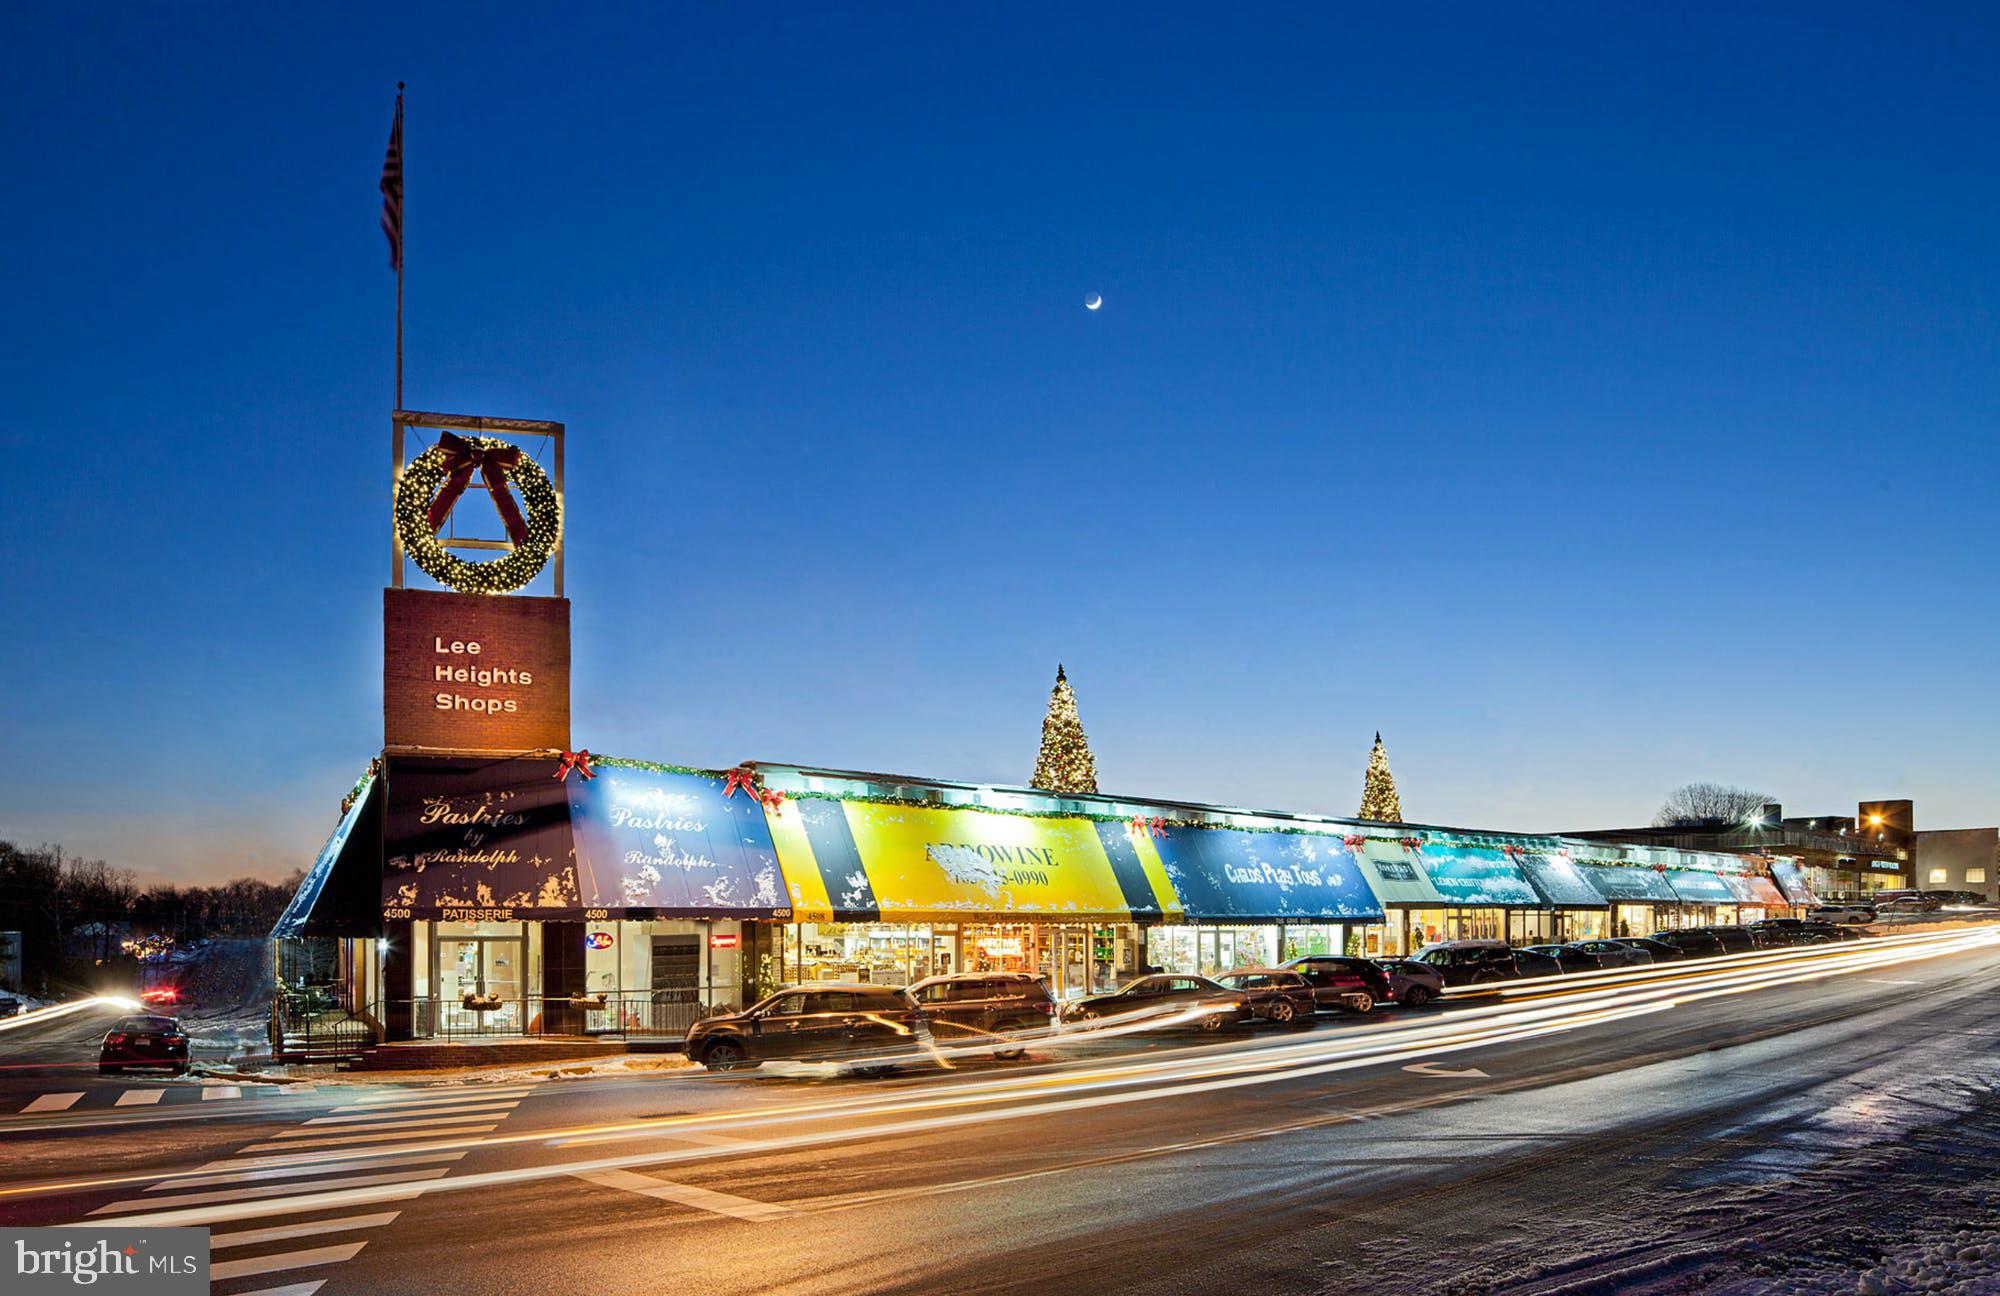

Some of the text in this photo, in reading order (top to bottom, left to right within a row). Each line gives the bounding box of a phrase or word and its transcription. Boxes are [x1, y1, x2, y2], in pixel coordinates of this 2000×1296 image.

[435, 637, 481, 654] Lee
[435, 665, 533, 687] Heights
[435, 693, 518, 715] Shops
[420, 802, 529, 826] Pastries
[608, 807, 708, 832] Pastries
[427, 849, 521, 869] Randolph
[623, 850, 713, 872] Randolph
[383, 908, 513, 920] 4500 PATISSERIE
[585, 909, 608, 919] 4500
[772, 908, 791, 918] 4500
